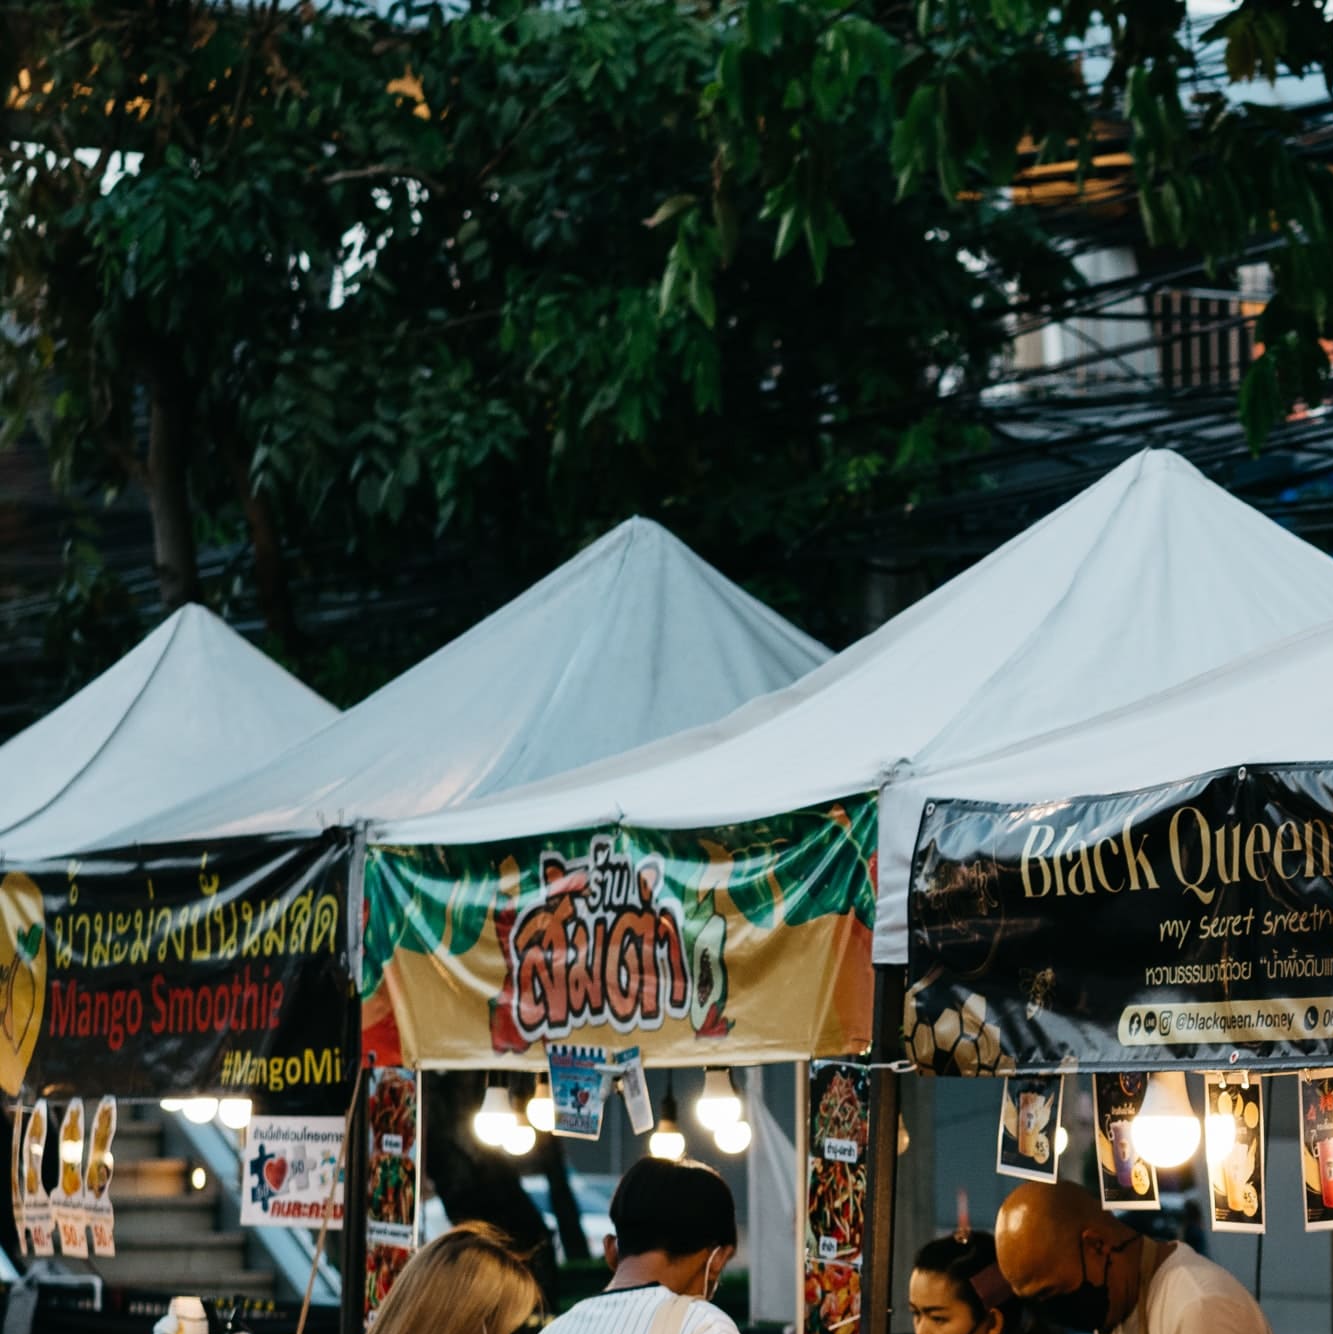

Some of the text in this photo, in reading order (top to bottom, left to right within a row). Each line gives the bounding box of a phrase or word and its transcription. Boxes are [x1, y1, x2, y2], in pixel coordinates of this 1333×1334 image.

[590, 842, 633, 912] ร้าน
[1020, 812, 1160, 898] Black
[54, 851, 340, 969] น้ำมะม่วงปั่นนมสด
[1160, 919, 1191, 949] my
[1199, 908, 1256, 940] secret
[50, 964, 285, 1051] Mango Smoothie
[1175, 1009, 1295, 1035] @blackqueen.honey
